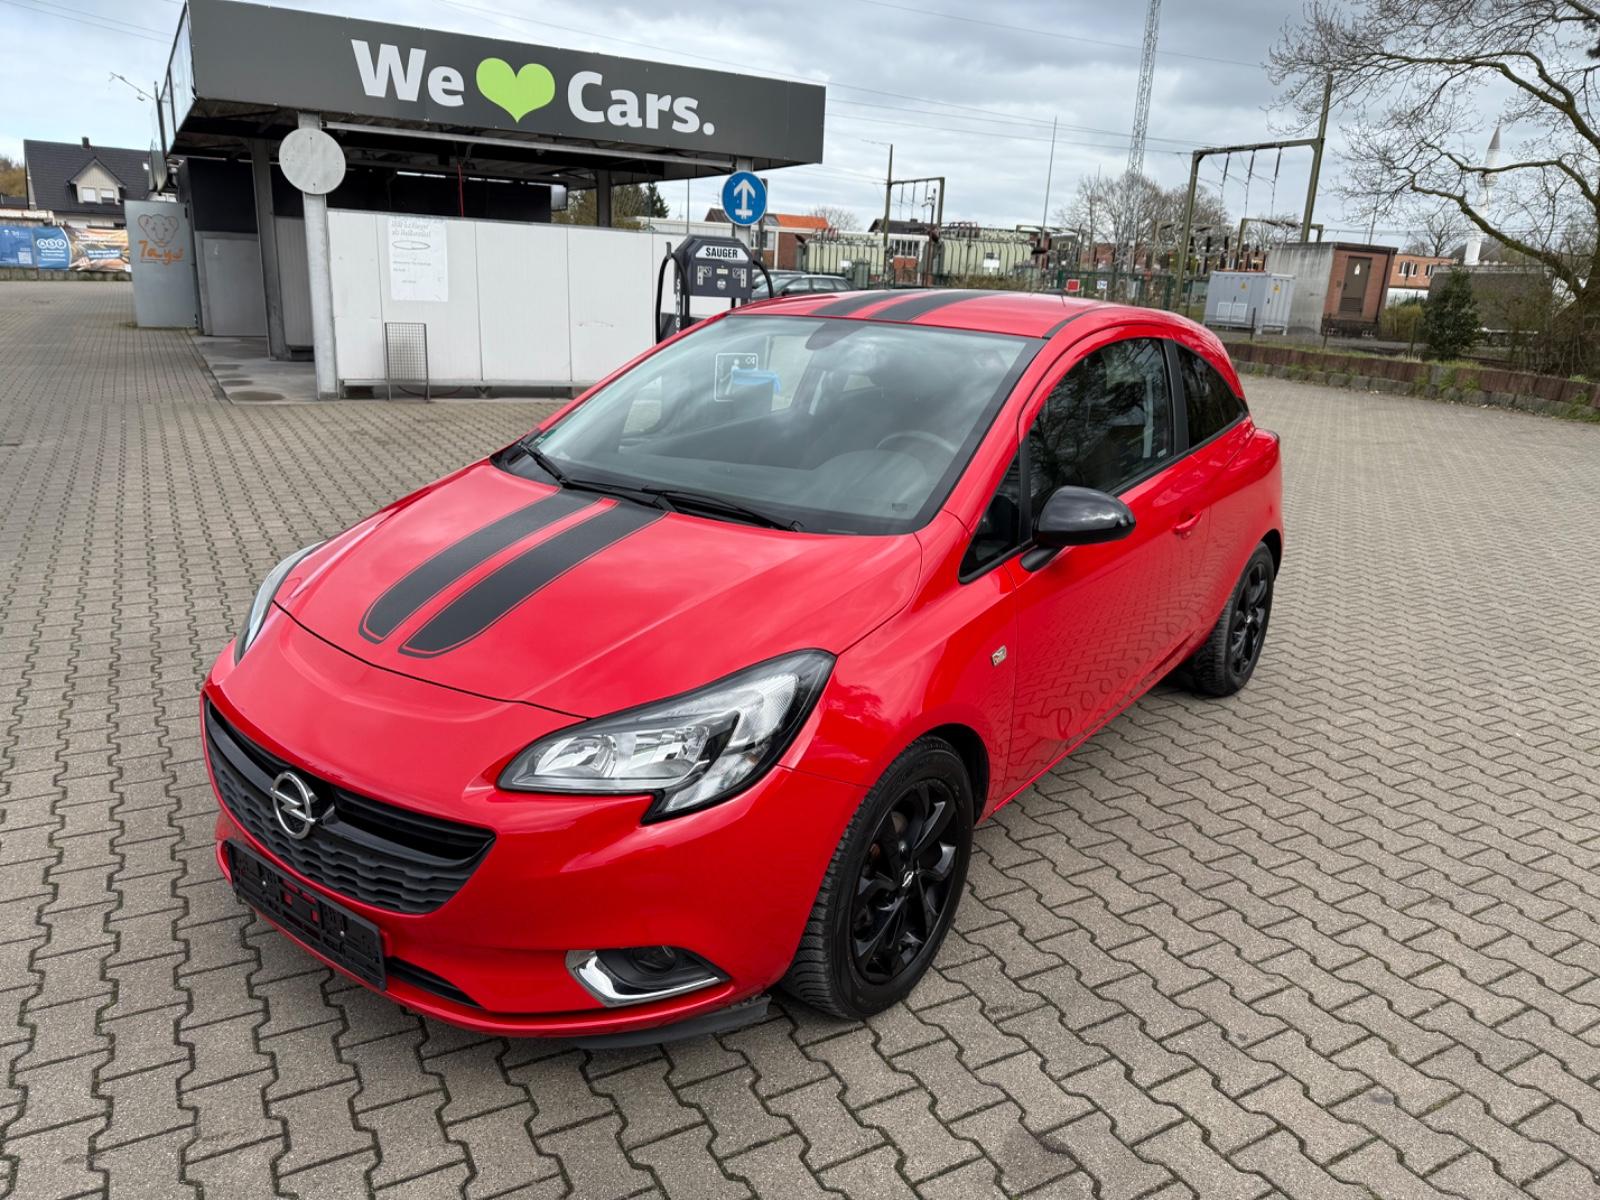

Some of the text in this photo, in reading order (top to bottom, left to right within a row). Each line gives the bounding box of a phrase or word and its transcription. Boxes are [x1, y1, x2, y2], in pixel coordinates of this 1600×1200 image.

[351, 38, 715, 136] We Cars.
[705, 246, 738, 259] SAUGER
